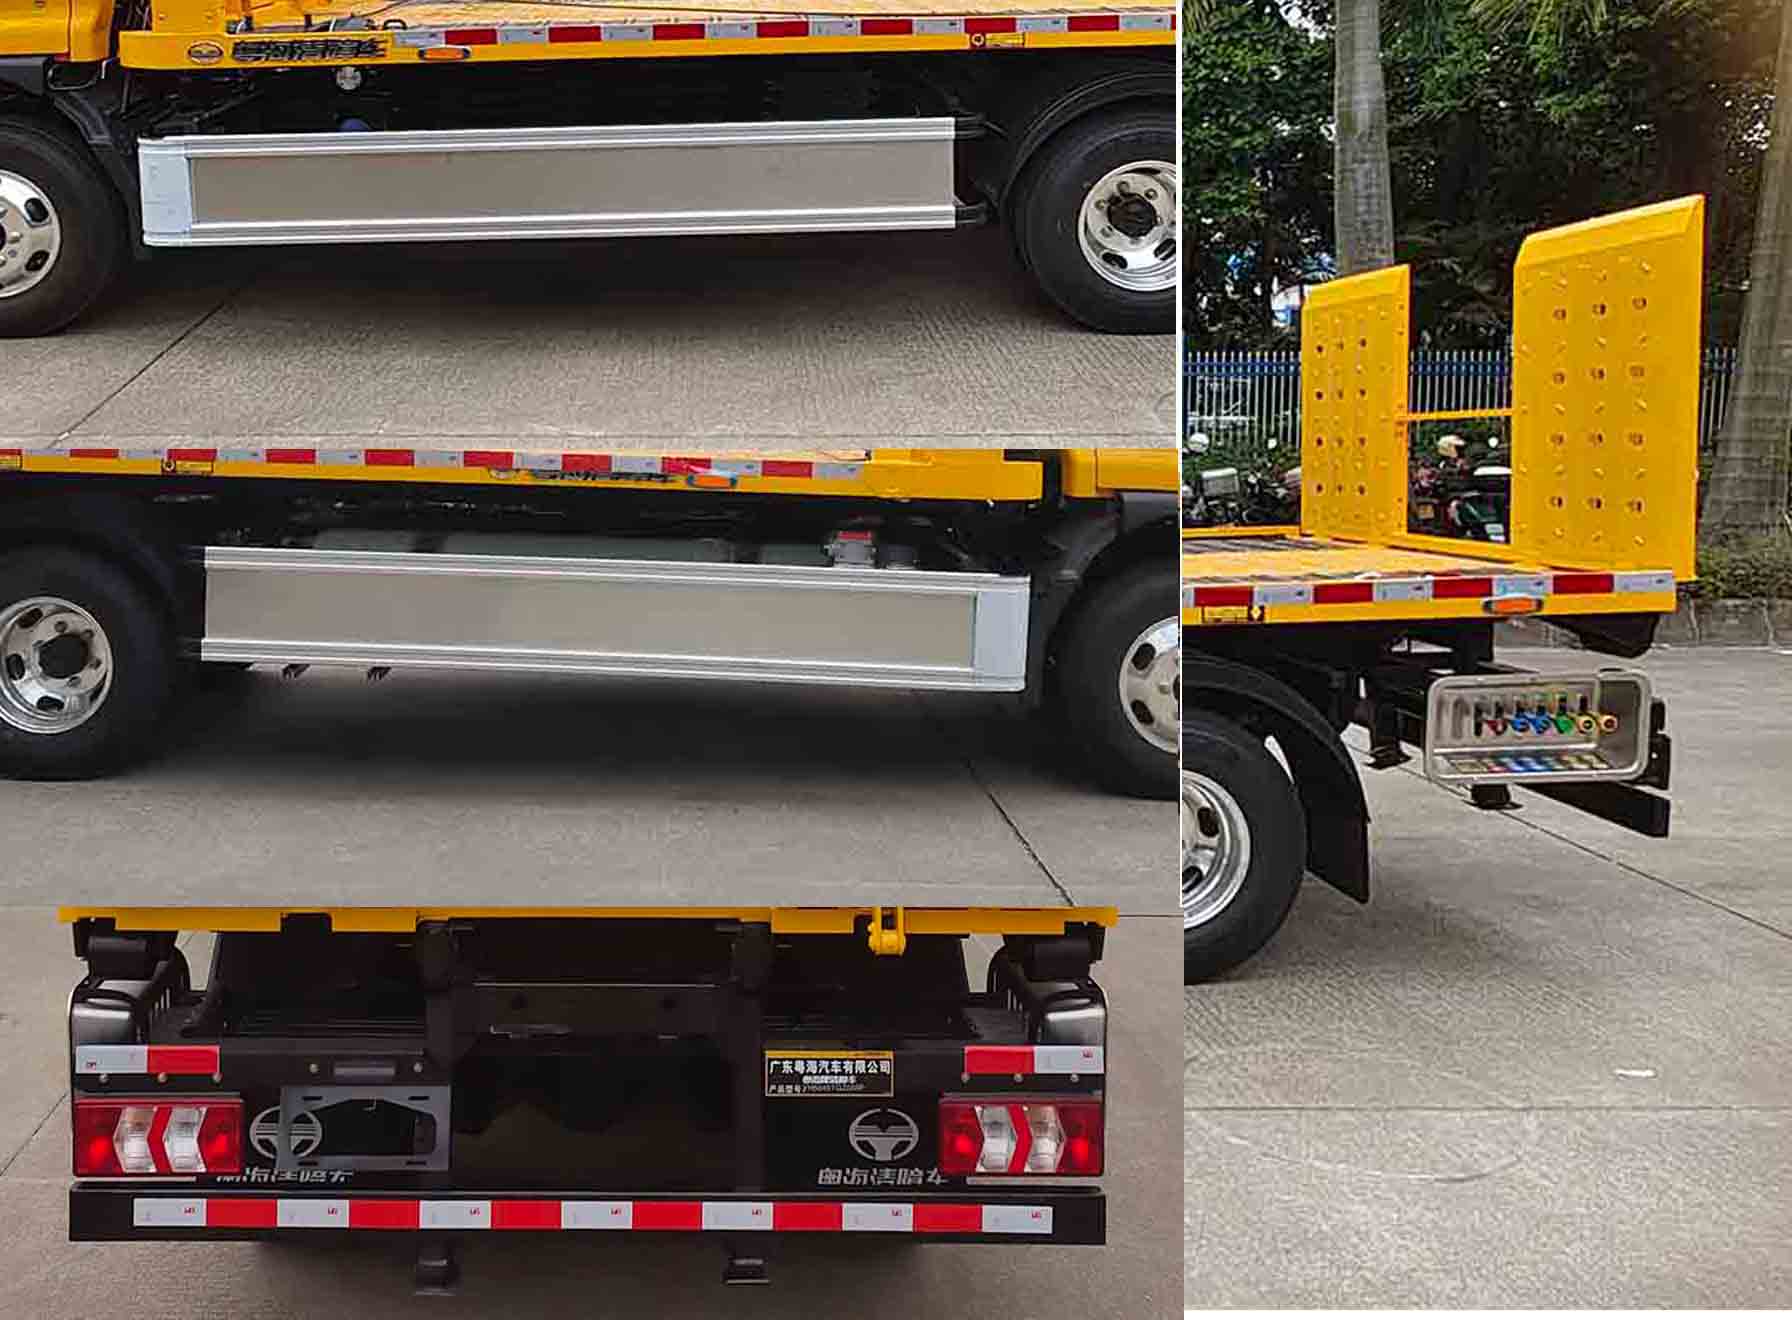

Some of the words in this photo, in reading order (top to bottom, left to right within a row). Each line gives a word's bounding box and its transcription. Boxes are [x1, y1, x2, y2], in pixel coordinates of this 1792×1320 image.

[770, 1060, 891, 1074] 广东粤海汽车有限公司
